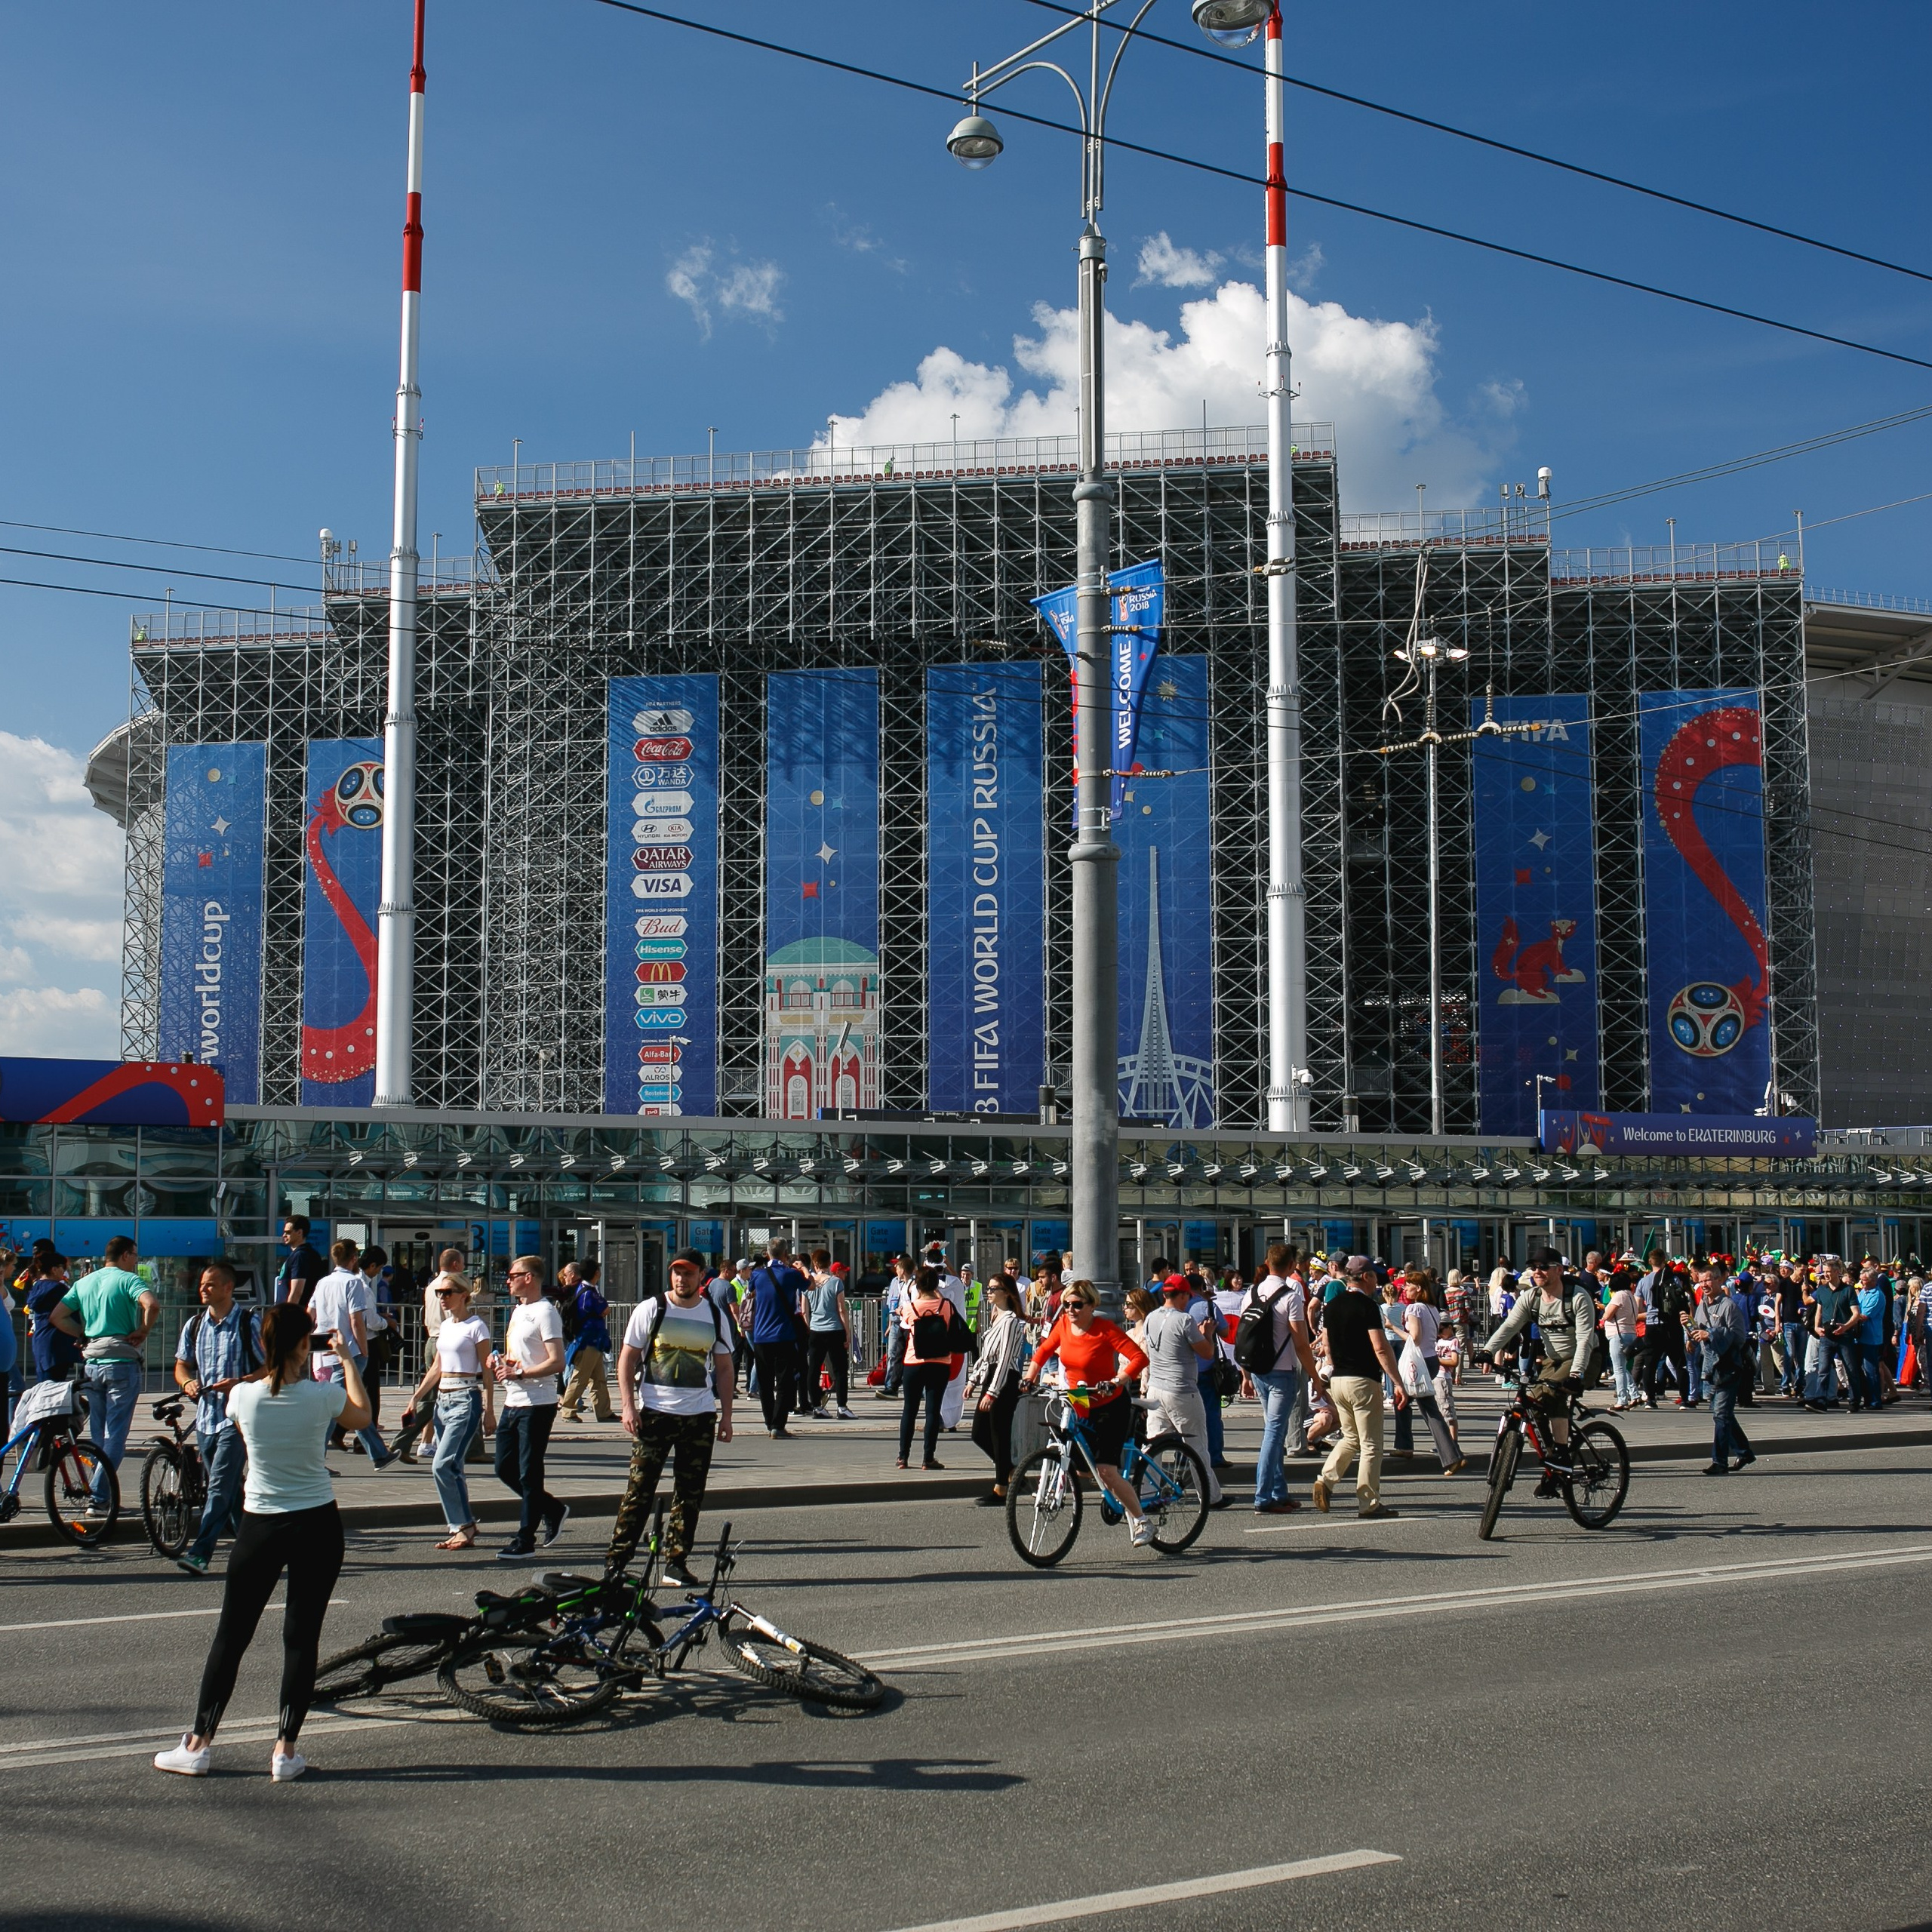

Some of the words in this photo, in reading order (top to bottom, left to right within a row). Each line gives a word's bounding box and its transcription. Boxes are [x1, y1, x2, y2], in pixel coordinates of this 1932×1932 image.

[1129, 589, 1157, 604] RUSSIA
[1130, 601, 1149, 612] 2018
[1118, 640, 1131, 749] WELCOME
[1503, 718, 1570, 743] FIFA
[641, 741, 686, 757] Coca-Cola
[972, 687, 998, 809] RUSSIA
[657, 766, 686, 779] 万达
[655, 805, 681, 814] GAZPROM
[636, 848, 687, 863] QATAR
[973, 817, 998, 886] CUP
[648, 860, 687, 869] AIRWAYS
[641, 878, 682, 893] VISA
[639, 918, 682, 935] Bud
[640, 946, 683, 954] Hisense
[974, 893, 999, 1013] WORLD
[195, 901, 230, 1064] worldcup
[657, 989, 681, 1001] 蒙牛
[640, 1011, 681, 1023] vivo
[974, 1020, 999, 1089] FIFA
[1623, 1127, 1673, 1142] Welcome
[1675, 1129, 1686, 1142] to
[1688, 1128, 1777, 1144] EKATERINBURG
[694, 1226, 715, 1236] Gate
[870, 1226, 889, 1236] Gate
[1035, 1226, 1051, 1235] Gate
[1186, 1226, 1201, 1235] Gate
[694, 1236, 714, 1245] Вход
[870, 1236, 888, 1245] Вход
